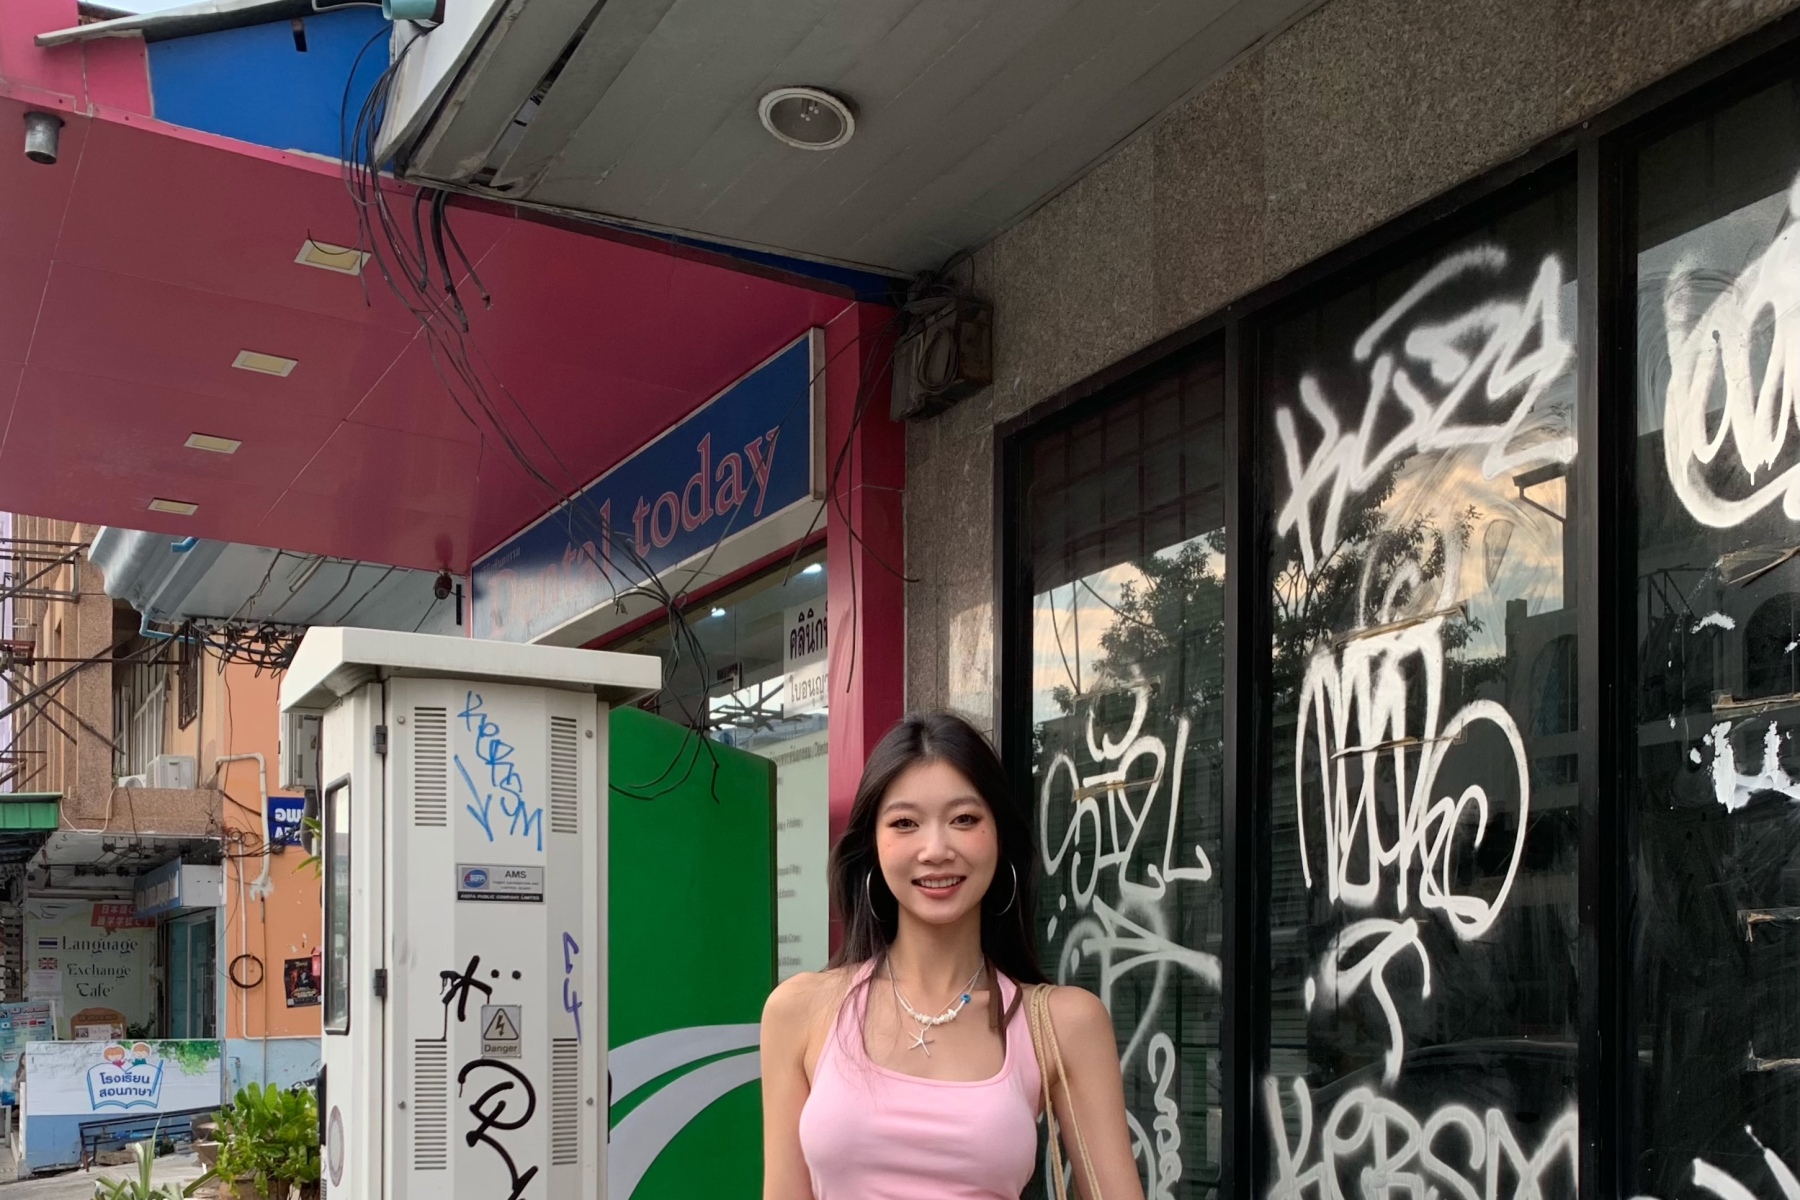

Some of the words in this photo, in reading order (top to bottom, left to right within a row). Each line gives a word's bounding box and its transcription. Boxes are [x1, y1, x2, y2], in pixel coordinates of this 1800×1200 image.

[632, 425, 780, 558] today
[504, 870, 527, 879] AMS
[62, 936, 138, 955] Language
[67, 963, 131, 979] Exchange
[484, 1044, 518, 1054] Danger
[99, 1071, 151, 1085] โรงเรียน
[99, 1086, 152, 1098] สอนภาษา
